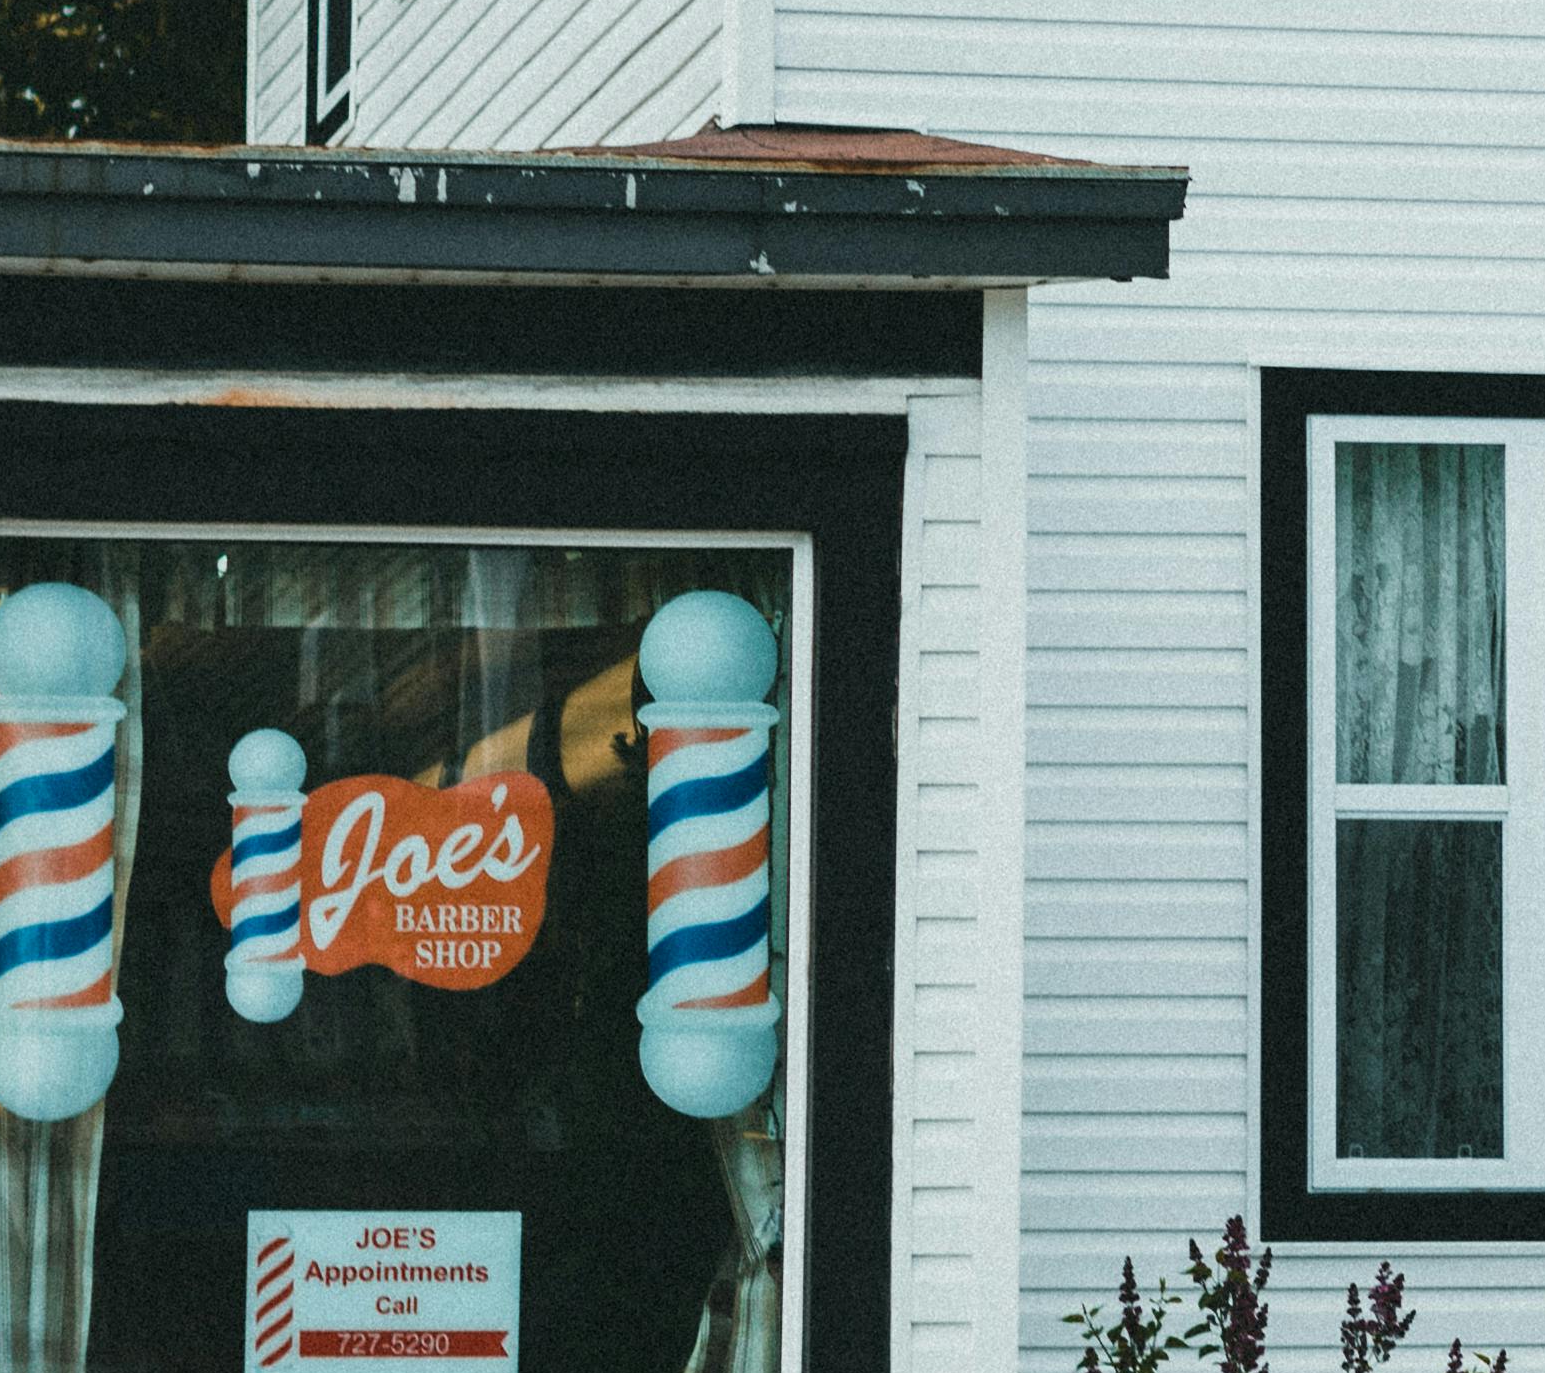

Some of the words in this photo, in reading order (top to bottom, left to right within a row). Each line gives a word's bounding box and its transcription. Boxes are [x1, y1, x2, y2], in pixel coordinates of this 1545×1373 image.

[308, 782, 541, 951] Joe's
[395, 906, 522, 933] BARBER
[414, 940, 502, 969] SHOP
[355, 1227, 437, 1250] JOE'S
[305, 1261, 489, 1286] Appointments
[375, 1296, 418, 1315] Call
[337, 1332, 450, 1355] 727-5290
